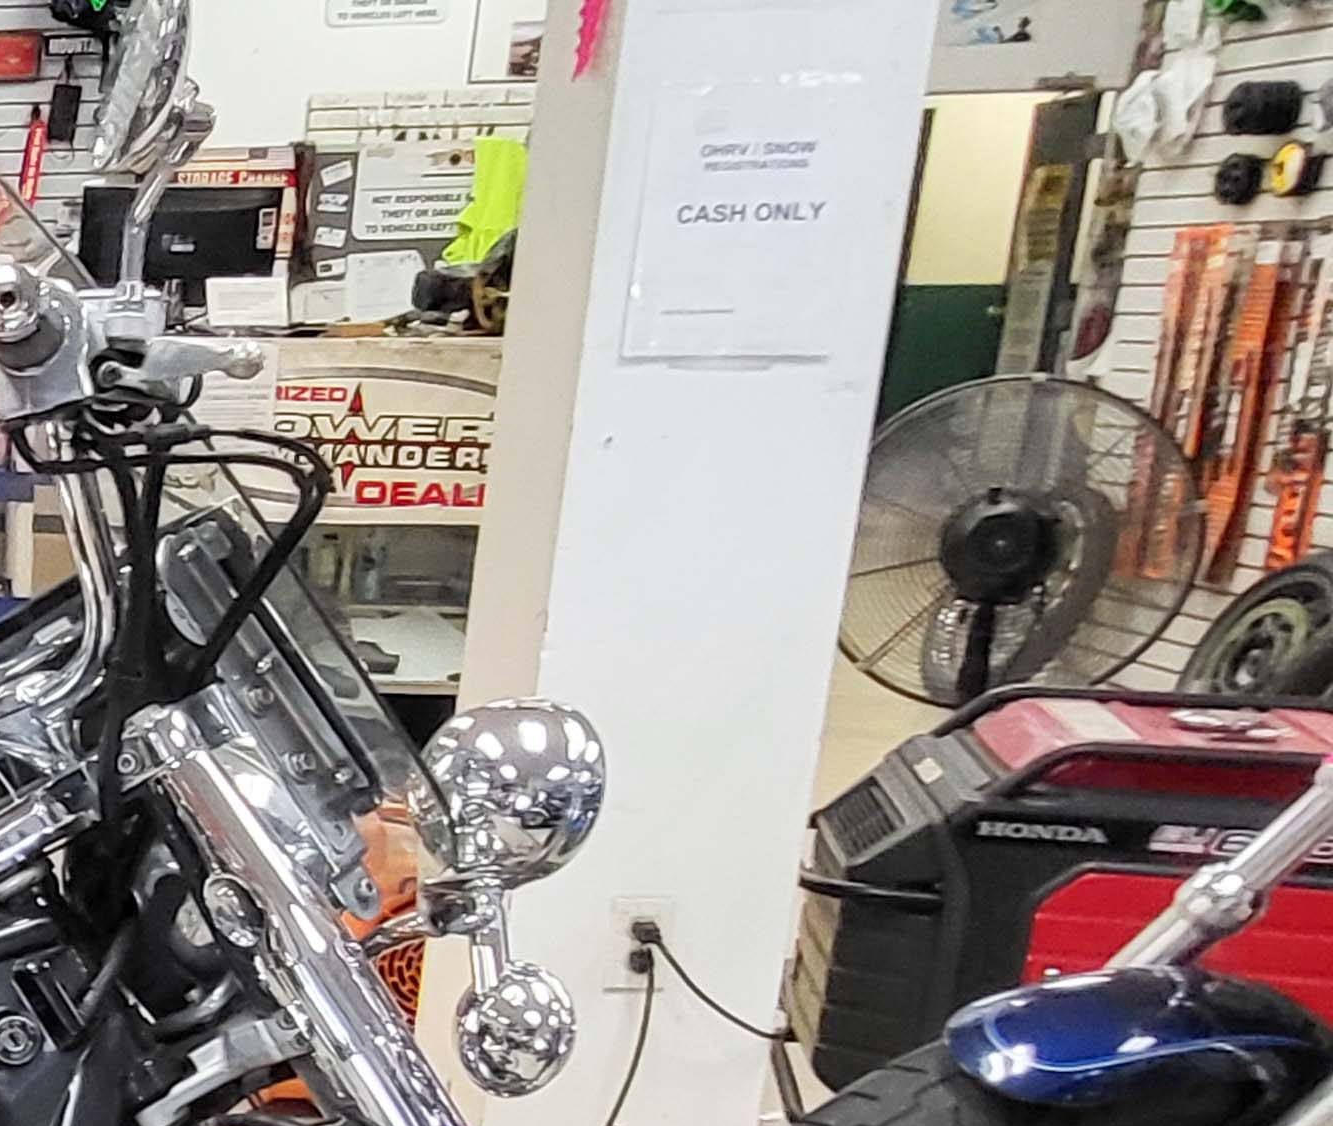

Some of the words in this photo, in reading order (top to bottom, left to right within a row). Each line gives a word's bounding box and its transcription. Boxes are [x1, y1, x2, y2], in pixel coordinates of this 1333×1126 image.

[763, 140, 817, 155] SNOW
[676, 203, 747, 224] CASH
[754, 201, 826, 222] ONLY
[976, 820, 1109, 844] HONDA
